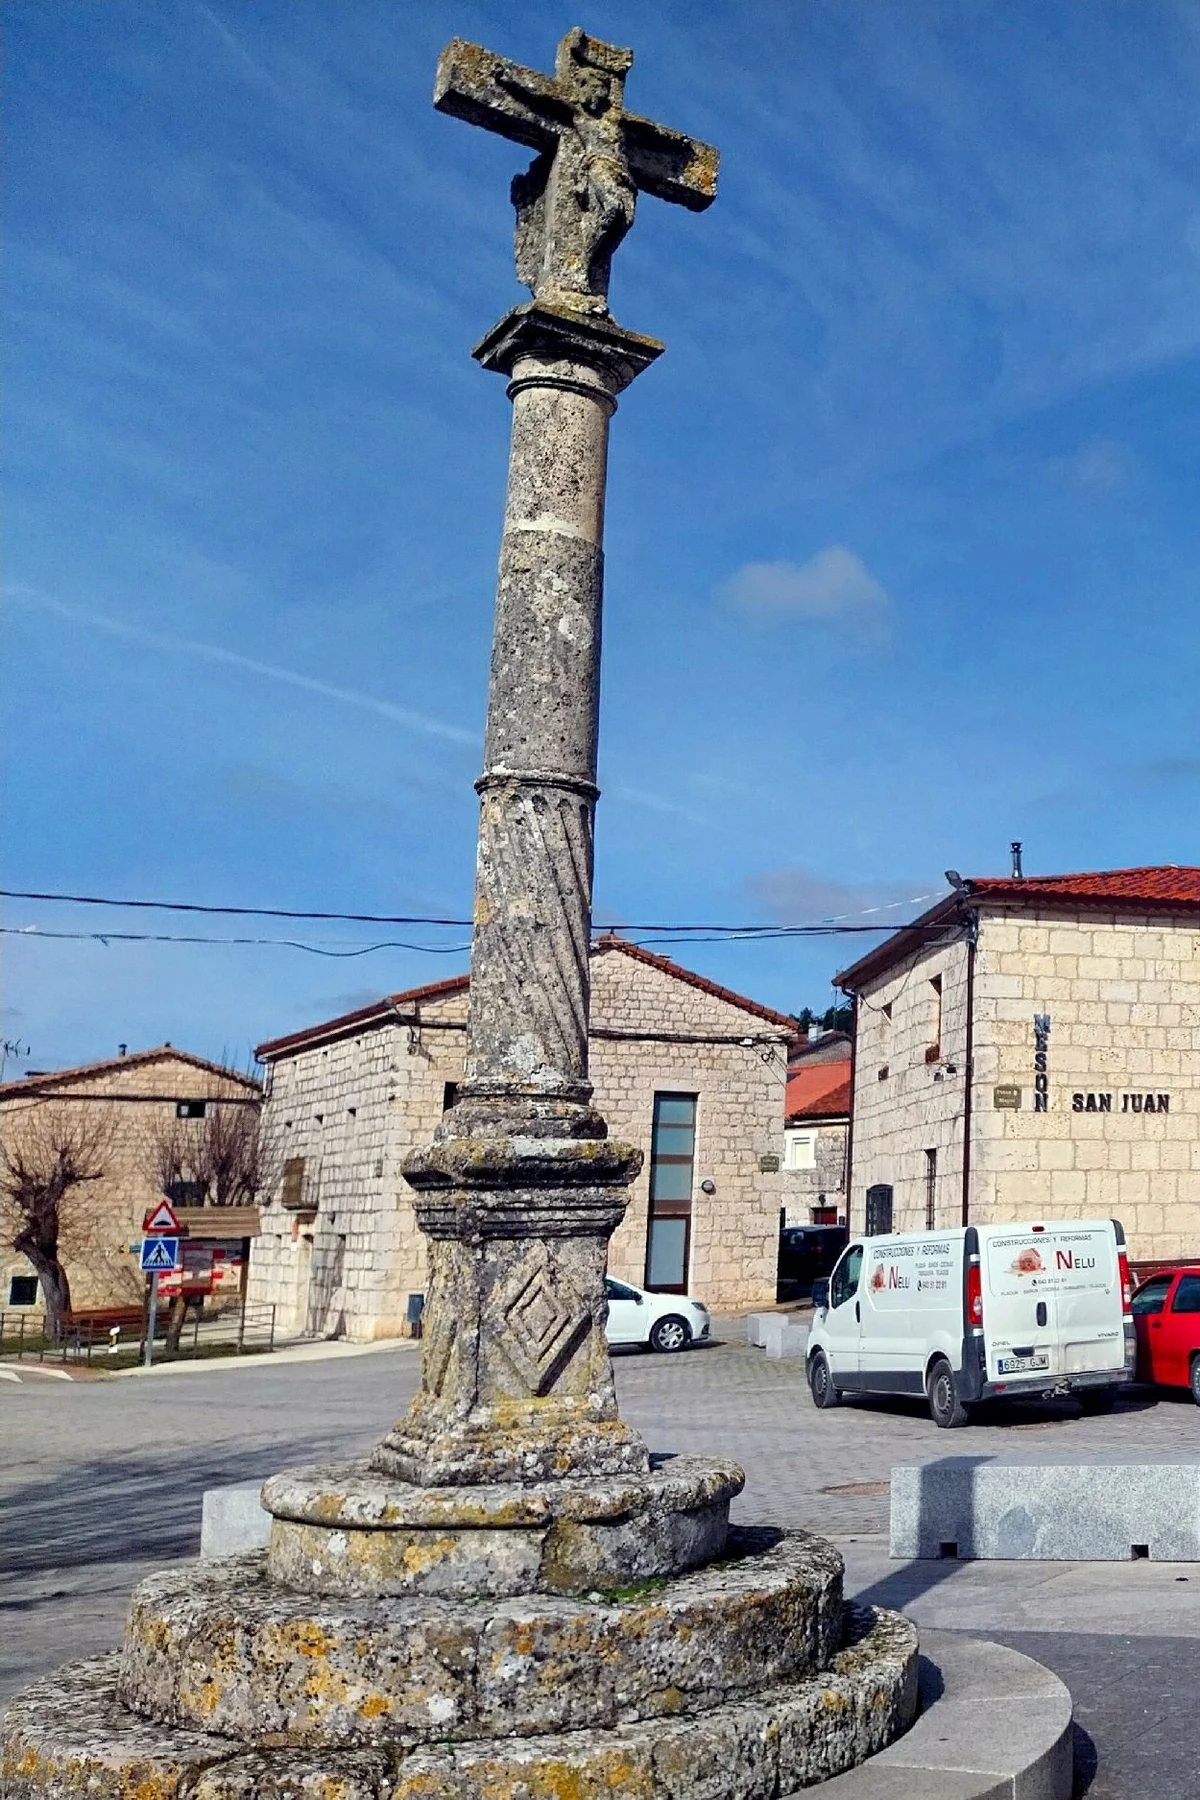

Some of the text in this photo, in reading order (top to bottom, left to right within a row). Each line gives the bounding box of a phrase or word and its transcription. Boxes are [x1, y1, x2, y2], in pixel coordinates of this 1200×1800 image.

[1034, 1014, 1050, 1112] MESON
[1072, 1093, 1170, 1113] SAN JUAN
[993, 1238, 1050, 1248] CONSTRUCCIONES
[1060, 1234, 1092, 1242] REFORMAS
[873, 1246, 915, 1260] CONSTRUCCIONES
[922, 1243, 950, 1256] REFORMAS
[1056, 1250, 1095, 1270] NELU
[1004, 1358, 1026, 1370] 6925
